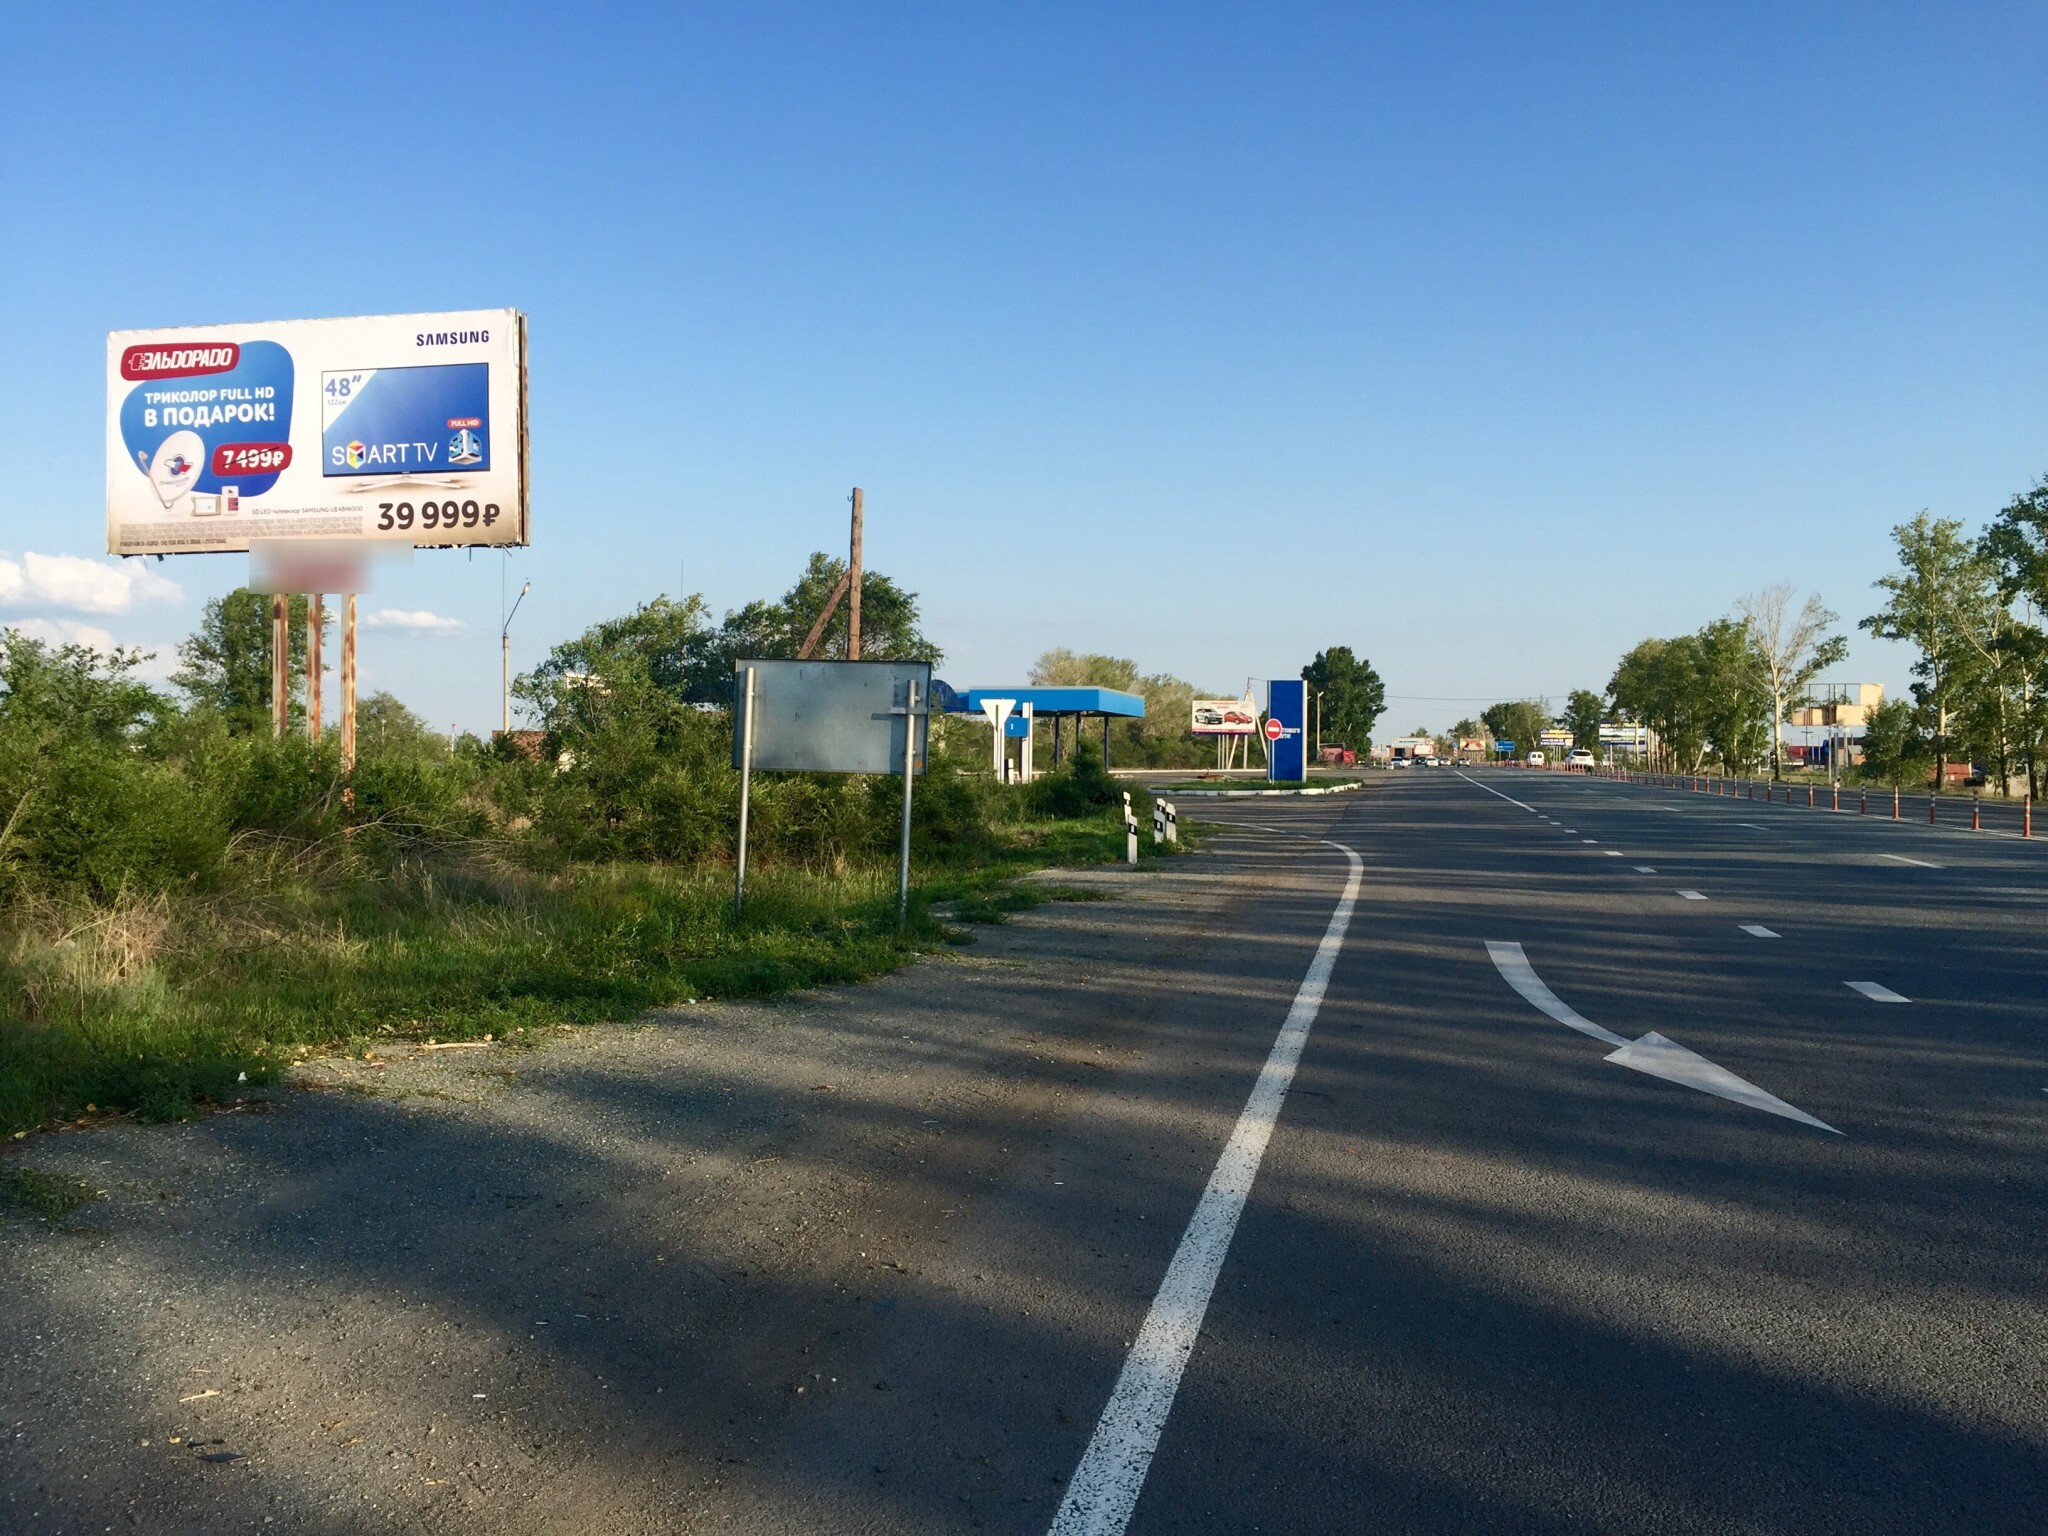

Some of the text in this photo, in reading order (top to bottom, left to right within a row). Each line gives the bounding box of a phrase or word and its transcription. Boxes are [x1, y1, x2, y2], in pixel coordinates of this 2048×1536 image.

[416, 330, 490, 346] SAMSUNG
[144, 386, 275, 404] ТРИКОЛОР FULL HD
[144, 403, 275, 429] В ПОДАРОК!
[451, 419, 479, 428] FULL HD
[331, 439, 438, 470] SMART TV
[301, 506, 329, 514] SAMSUNG
[378, 501, 415, 531] 39
